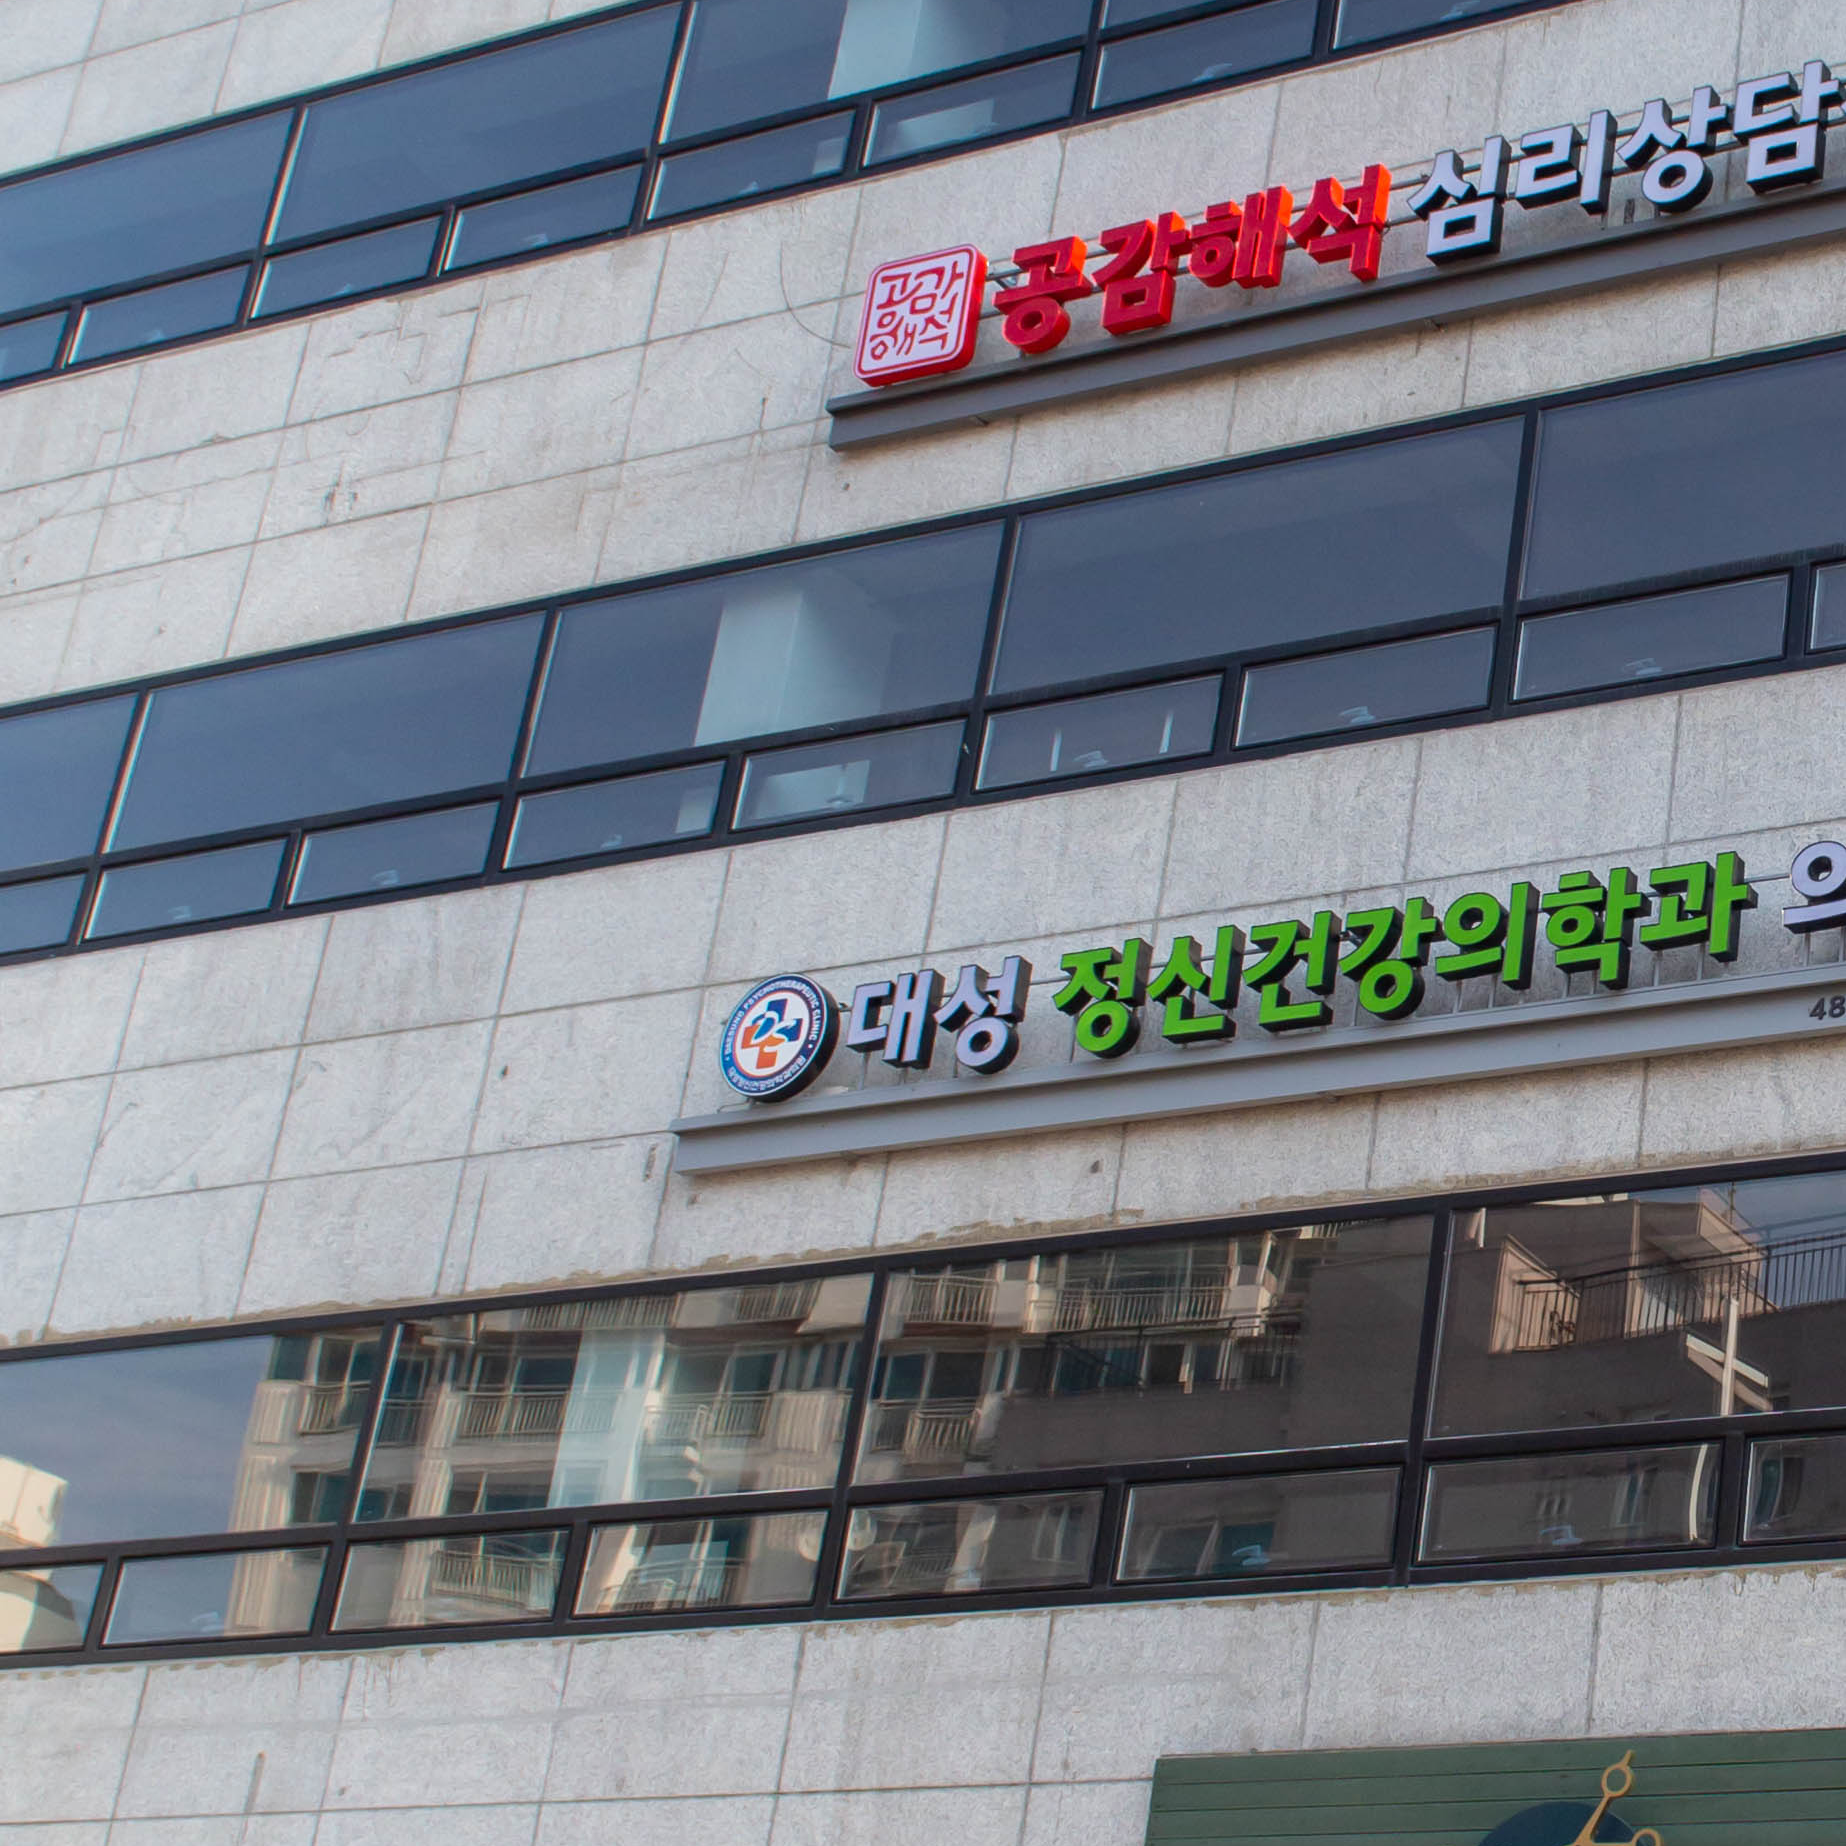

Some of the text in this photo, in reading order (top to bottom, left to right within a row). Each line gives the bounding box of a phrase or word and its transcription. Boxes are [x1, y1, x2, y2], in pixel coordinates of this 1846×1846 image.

[993, 163, 1394, 354] 공감해석
[845, 954, 1026, 1075] 대성
[1052, 850, 1758, 1061] 정신건강의학과
